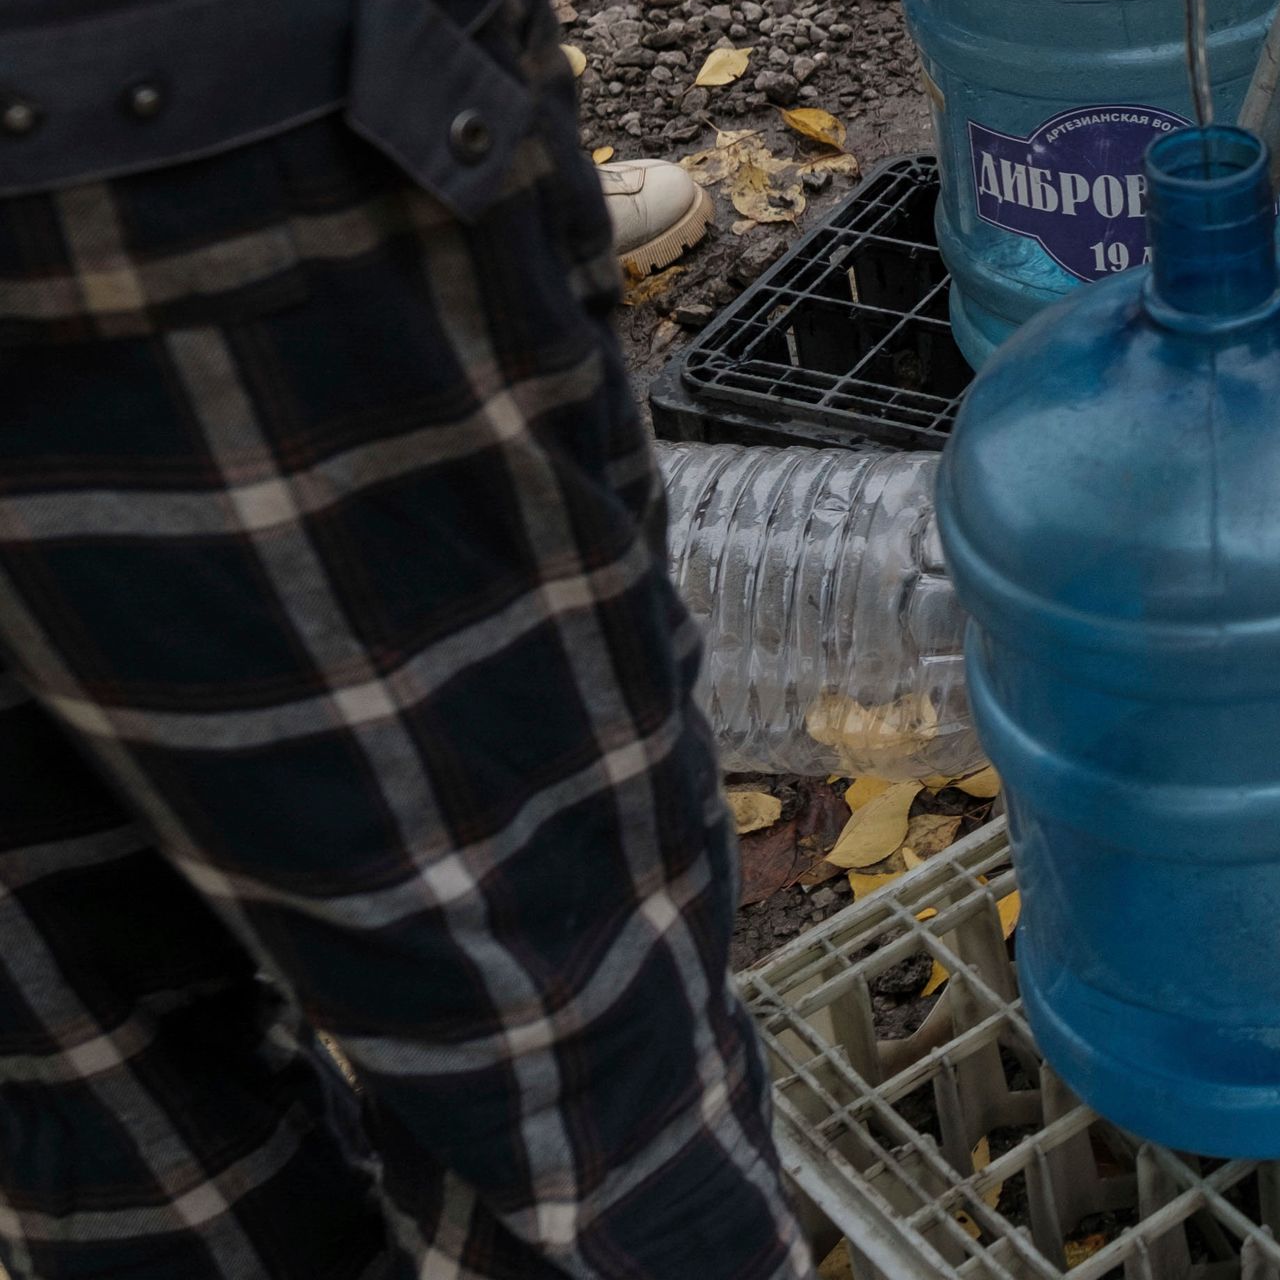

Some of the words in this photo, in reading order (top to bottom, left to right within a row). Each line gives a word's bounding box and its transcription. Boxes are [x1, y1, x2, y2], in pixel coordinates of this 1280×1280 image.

[1045, 113, 1149, 143] АРТЕЗИАНСКАЯ
[978, 151, 1148, 219] ДИБРОВ
[1090, 241, 1130, 272] 19
